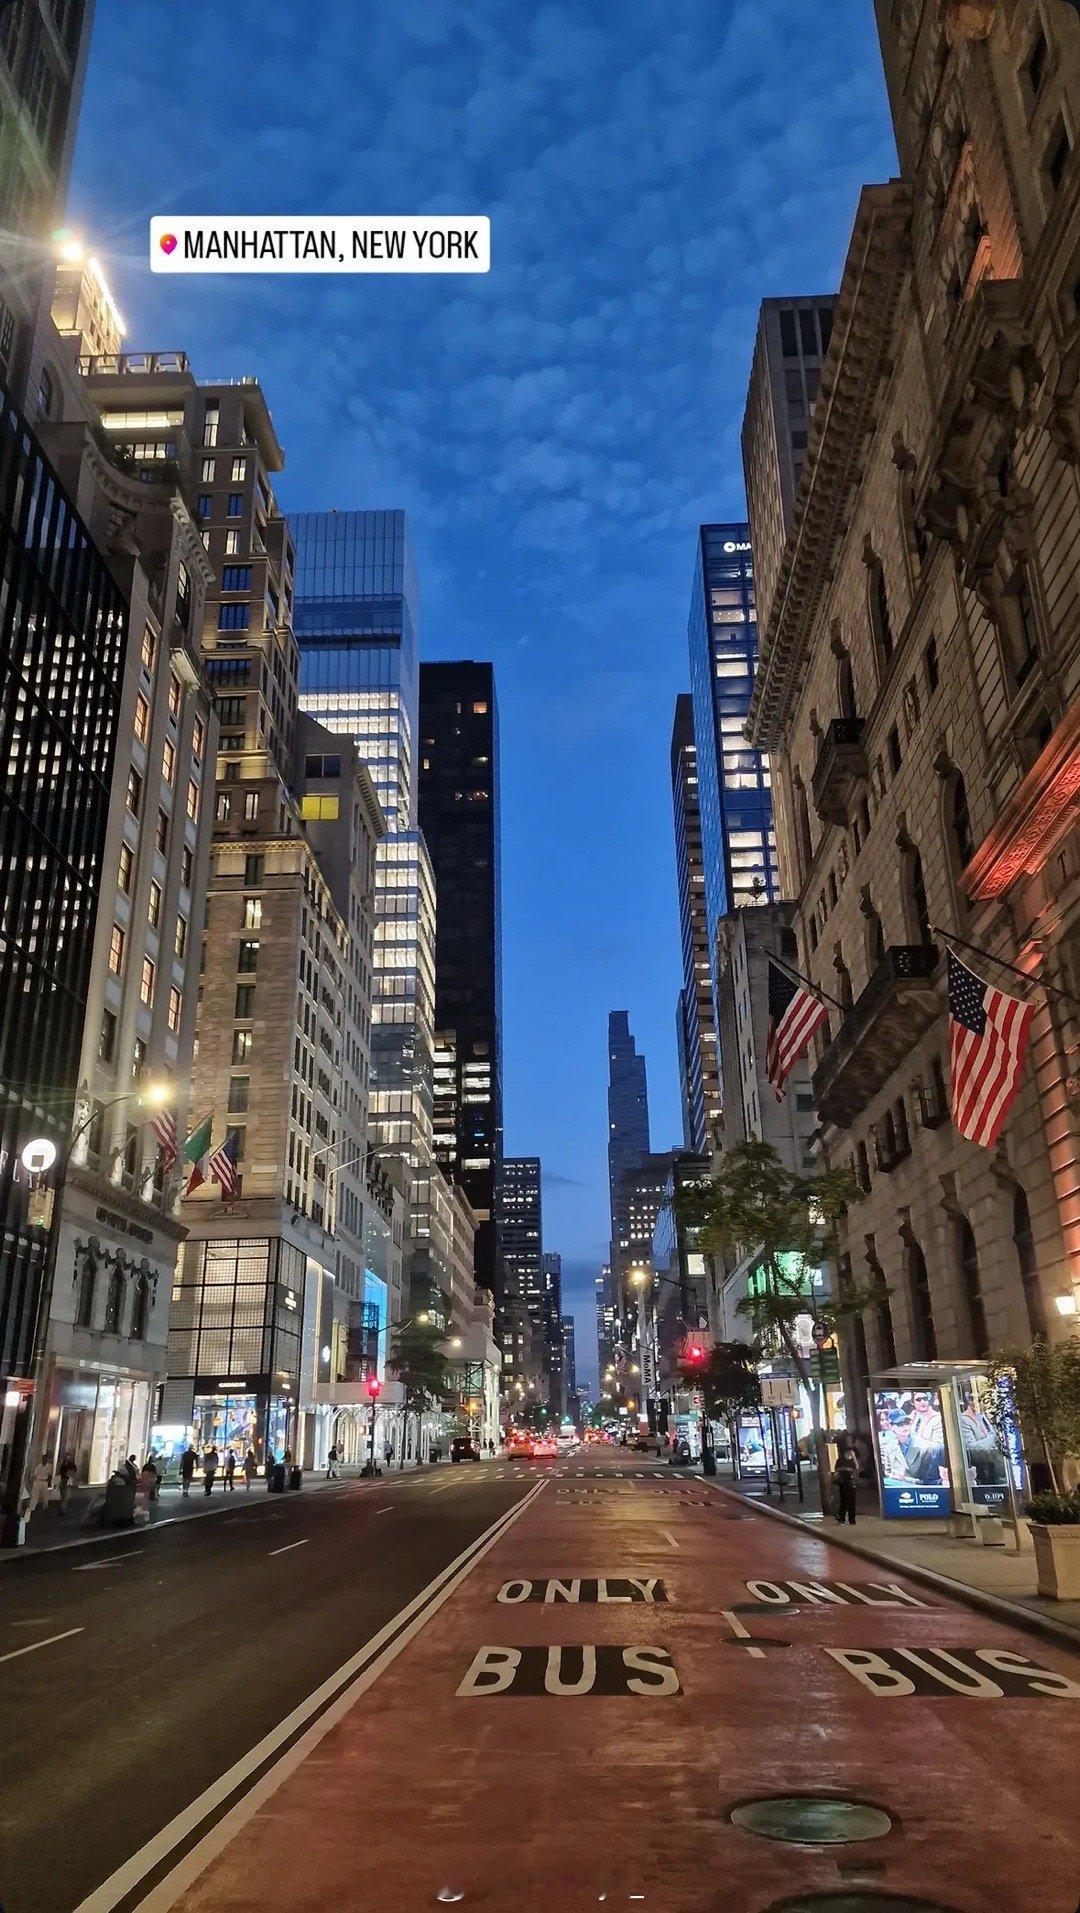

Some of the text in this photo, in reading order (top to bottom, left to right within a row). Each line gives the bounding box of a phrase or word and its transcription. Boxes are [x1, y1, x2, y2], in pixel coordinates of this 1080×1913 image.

[643, 1354, 652, 1384] MoMA
[919, 1493, 939, 1501] POLO
[496, 1579, 659, 1604] ONLY
[746, 1580, 931, 1608] ONLY
[455, 1645, 680, 1696] BUS
[823, 1647, 1080, 1699] BUS
